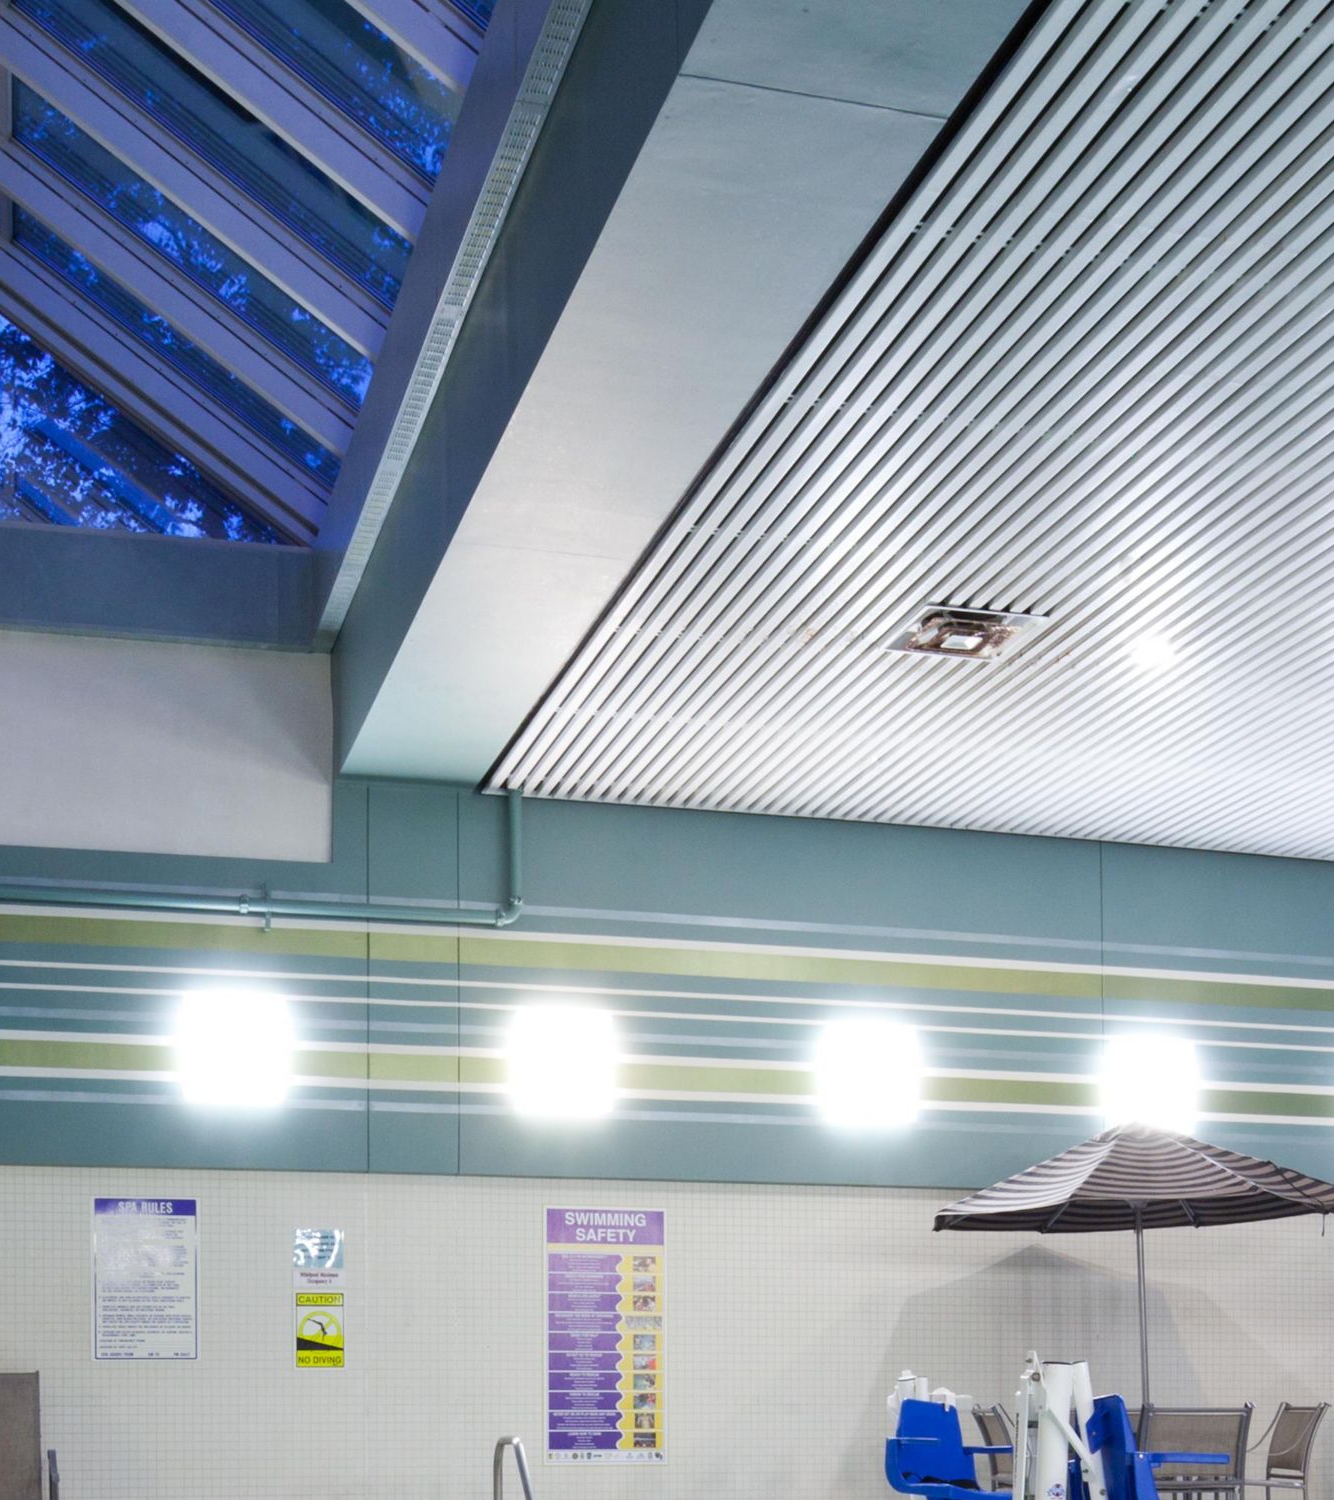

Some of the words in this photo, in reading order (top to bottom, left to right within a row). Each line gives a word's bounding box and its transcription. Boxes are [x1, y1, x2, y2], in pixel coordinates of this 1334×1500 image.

[118, 1201, 138, 1214] SPA
[141, 1202, 173, 1214] RULES
[564, 1212, 646, 1227] SWIMMING
[575, 1228, 636, 1242] SAFETY
[298, 1295, 341, 1304] CAUTION
[298, 1356, 311, 1364] NO
[313, 1356, 341, 1364] DIVING
